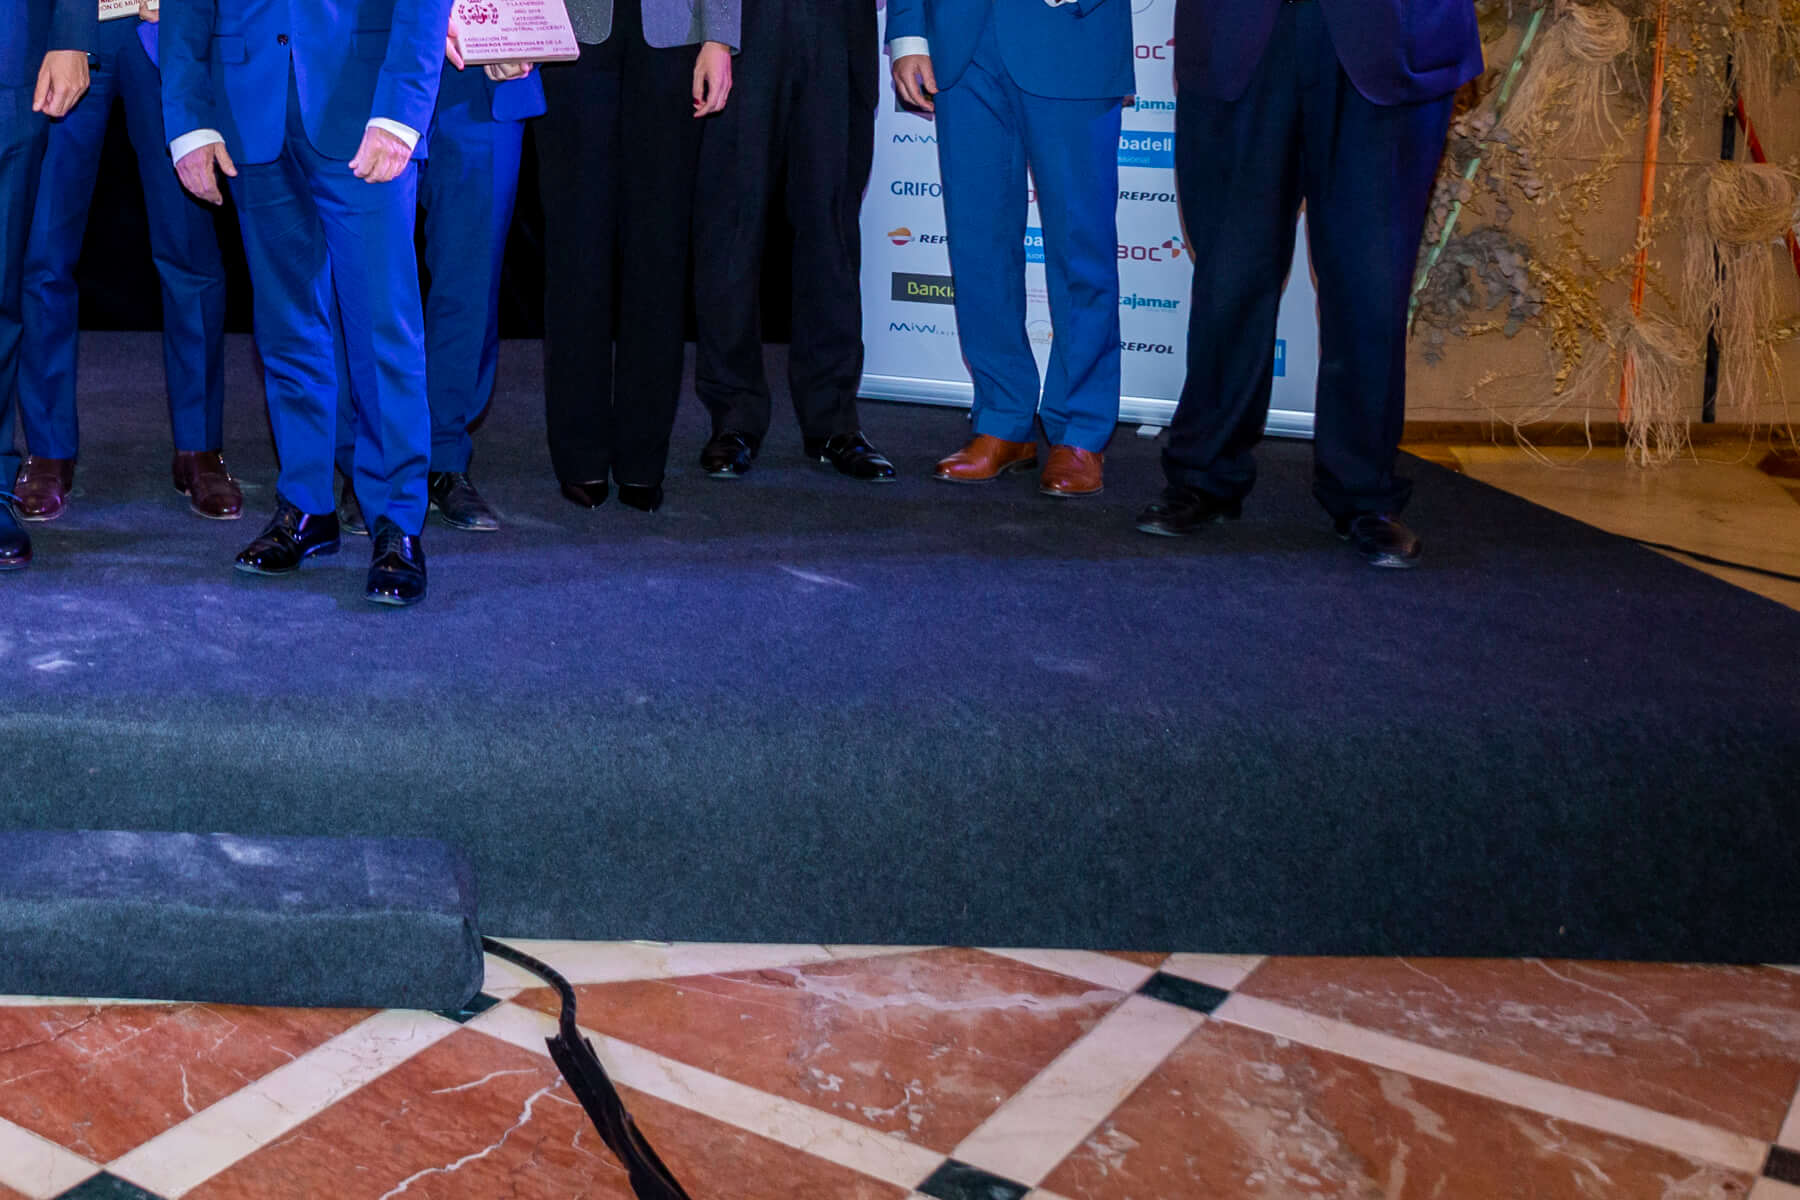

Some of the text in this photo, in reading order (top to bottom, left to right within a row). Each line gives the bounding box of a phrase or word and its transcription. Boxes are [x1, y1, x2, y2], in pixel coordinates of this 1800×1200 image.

[1134, 96, 1176, 113] jama
[1119, 137, 1172, 153] badell
[890, 180, 942, 198] GRIFO
[1119, 190, 1177, 203] REPSOL
[919, 234, 949, 245] REP
[1117, 245, 1163, 262] BOC
